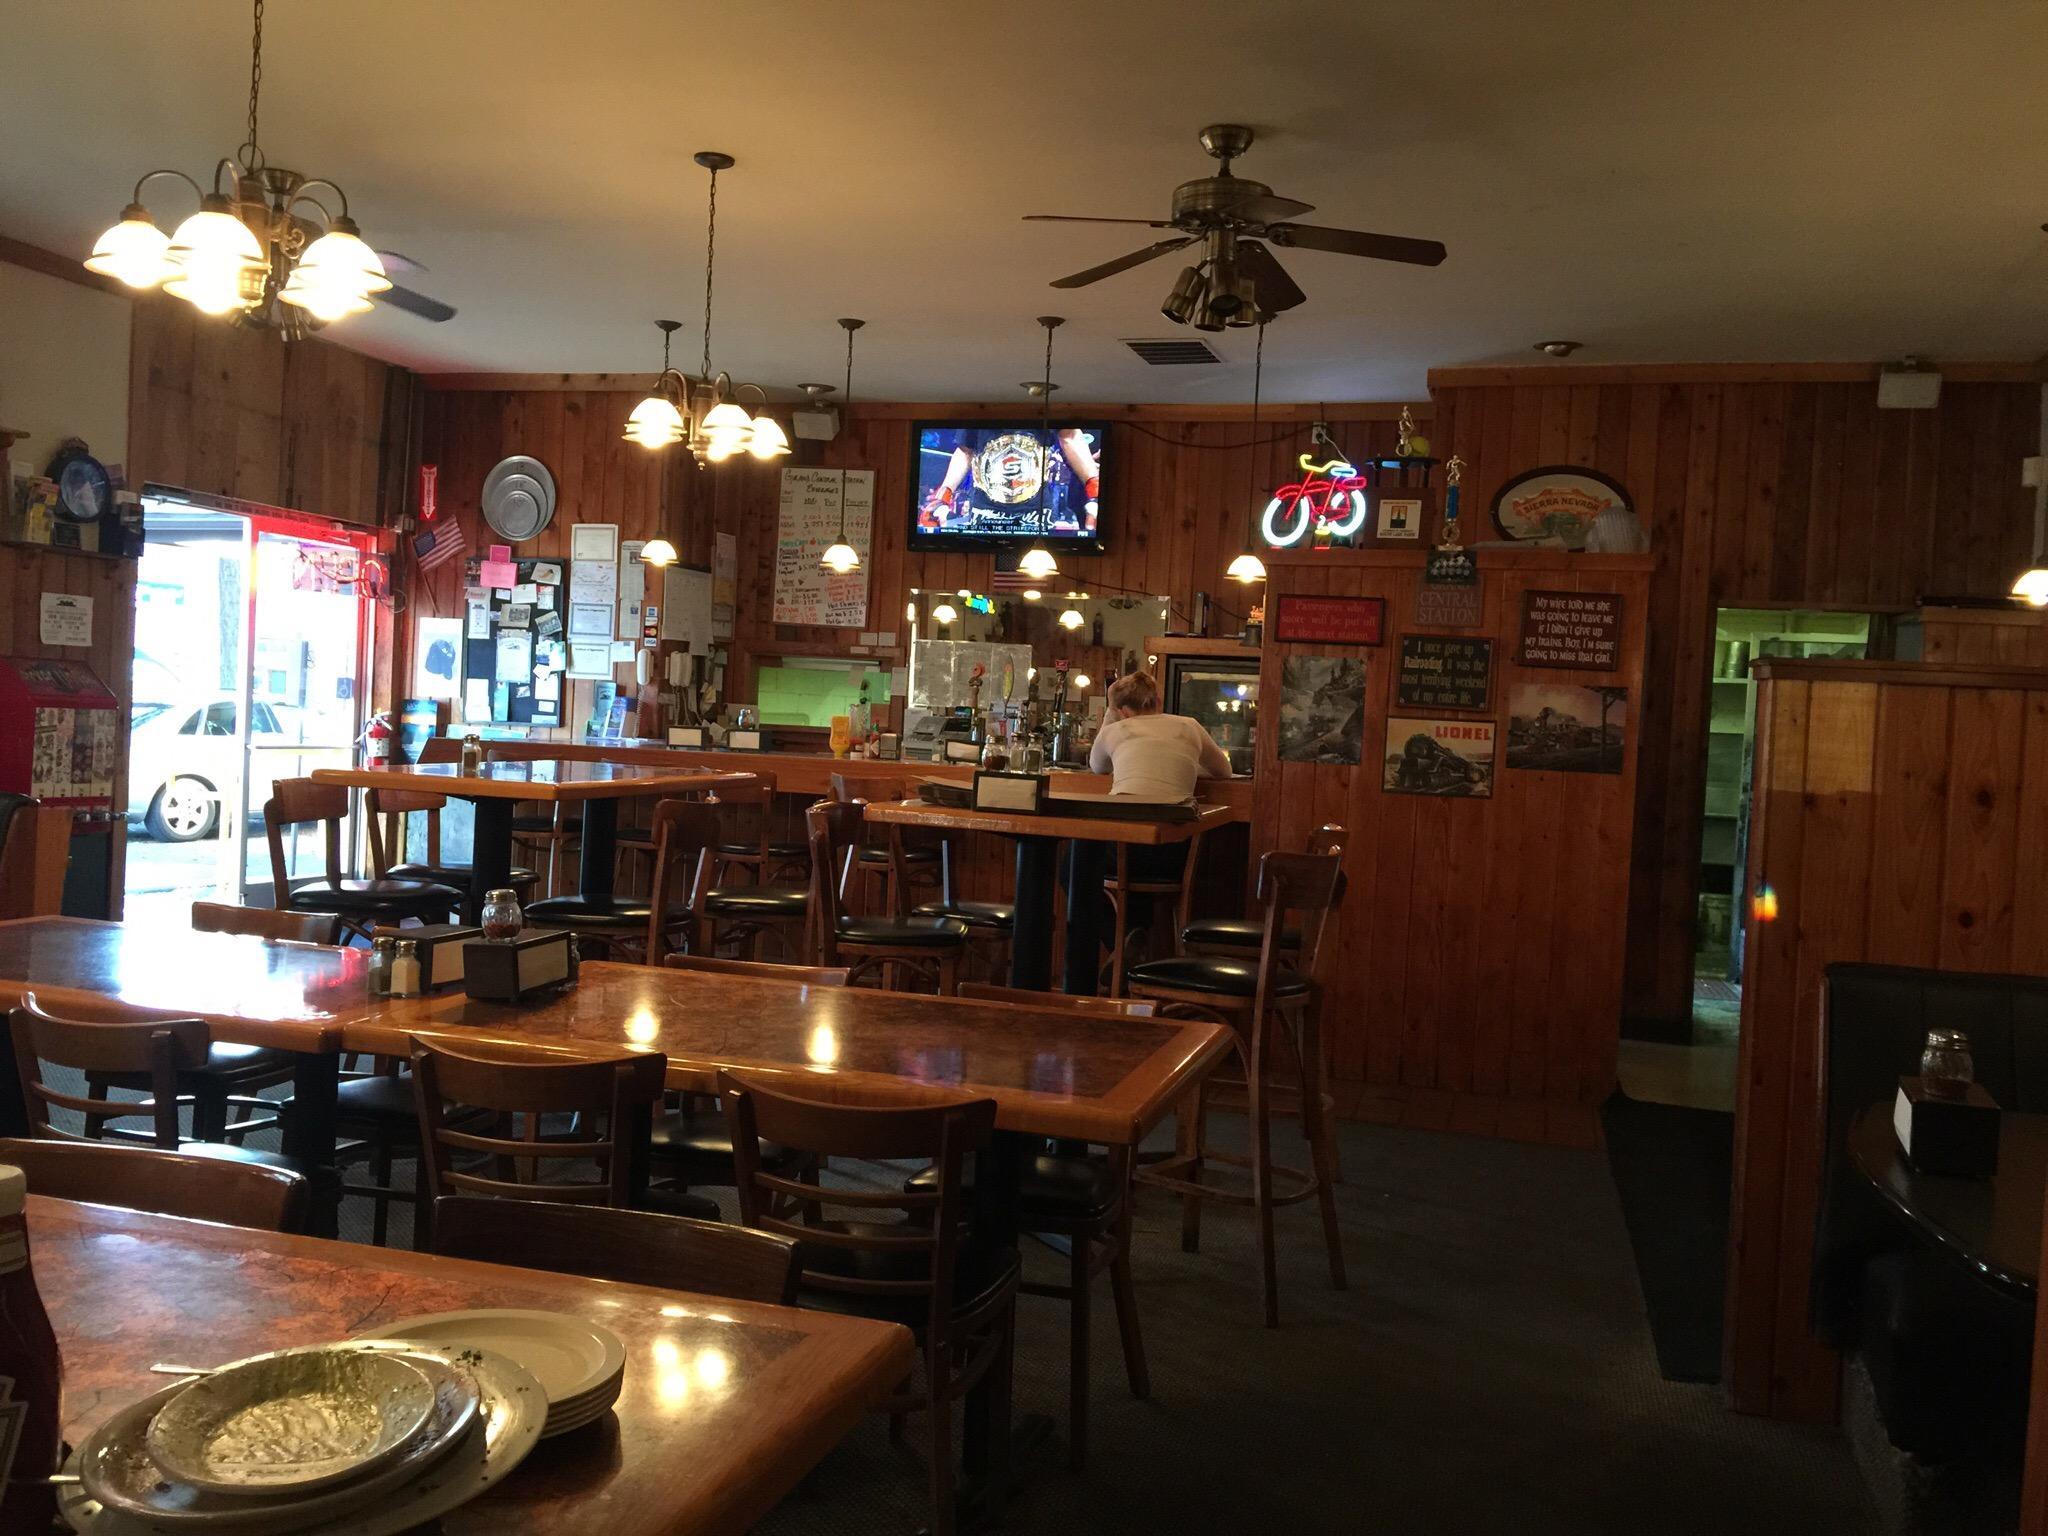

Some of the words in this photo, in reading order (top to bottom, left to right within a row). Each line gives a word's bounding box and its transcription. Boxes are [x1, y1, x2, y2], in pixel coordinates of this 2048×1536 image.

[1522, 497, 1559, 513] SIERRA
[1561, 496, 1600, 512] NEVADA
[1420, 591, 1478, 607] CENTRAL
[1419, 608, 1478, 624] STATION
[1418, 640, 1421, 653] I
[1435, 726, 1491, 740] LIONEL
